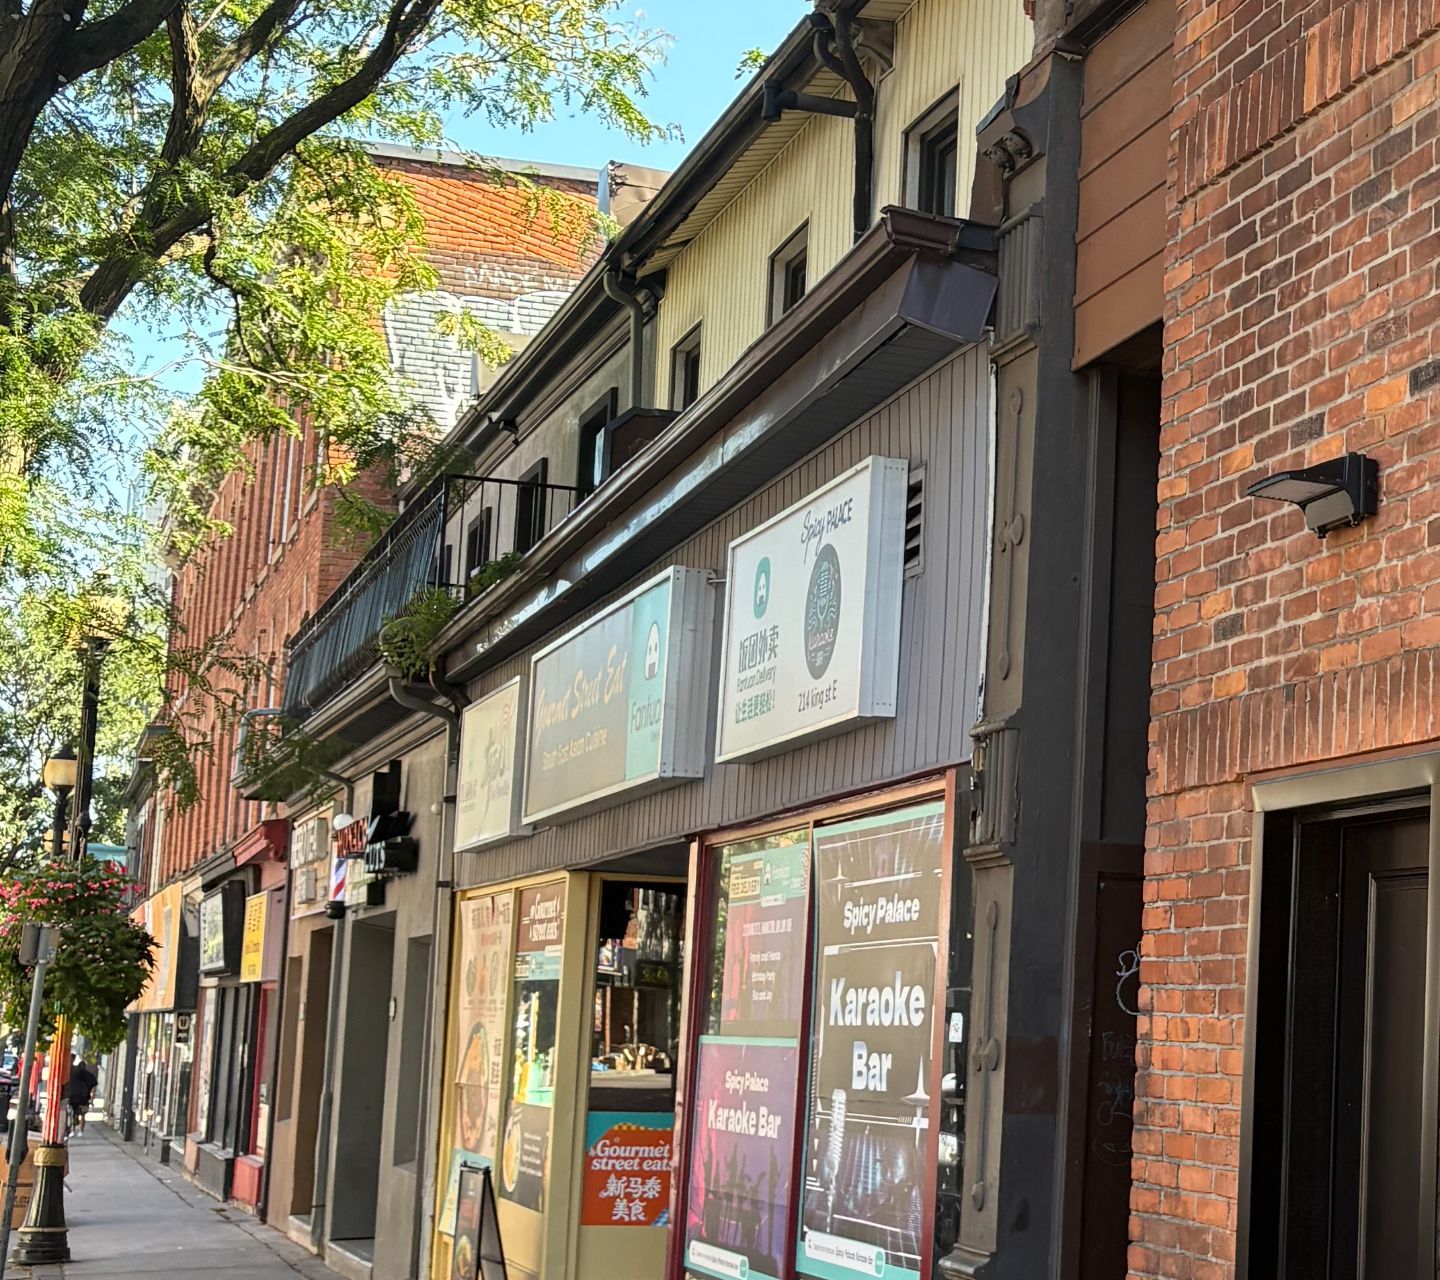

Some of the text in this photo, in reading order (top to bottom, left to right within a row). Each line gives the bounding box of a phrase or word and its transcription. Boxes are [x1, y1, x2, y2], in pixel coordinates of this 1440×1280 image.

[801, 497, 853, 564] Spicy PALACE
[738, 624, 779, 673] 饭团外卖
[604, 643, 628, 705] Eat
[798, 689, 810, 713] 214
[843, 893, 920, 935] Spicy Palace
[829, 970, 925, 1028] Karaoke
[725, 1070, 769, 1096] Spicy Palace
[851, 1040, 892, 1093] Bar
[708, 1099, 782, 1139] Karaoke Bar
[591, 1156, 641, 1171] street
[599, 1173, 662, 1199] 新马泰
[611, 1198, 647, 1222] 美食
